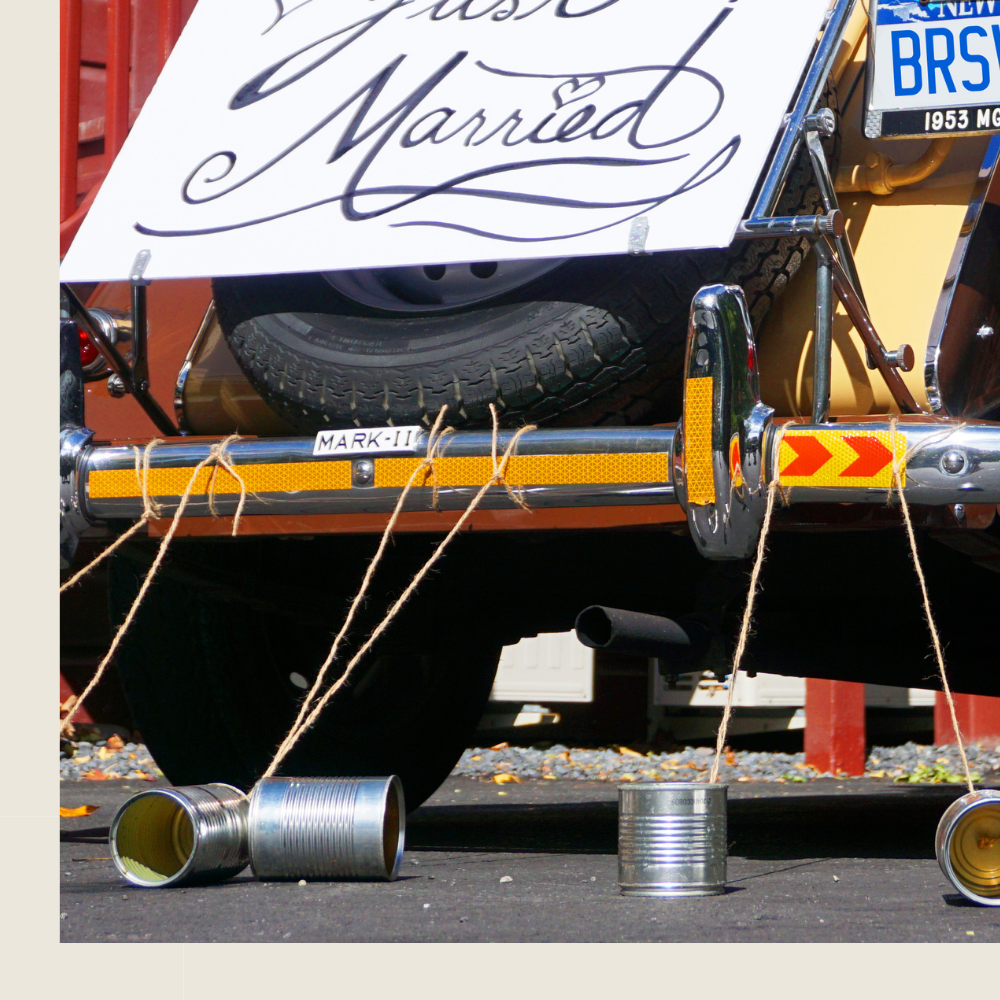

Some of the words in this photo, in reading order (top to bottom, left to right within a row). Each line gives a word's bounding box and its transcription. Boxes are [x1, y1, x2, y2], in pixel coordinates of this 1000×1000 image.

[181, 7, 733, 221] Married
[924, 109, 969, 132] 1953
[318, 430, 412, 451] MARK-II
